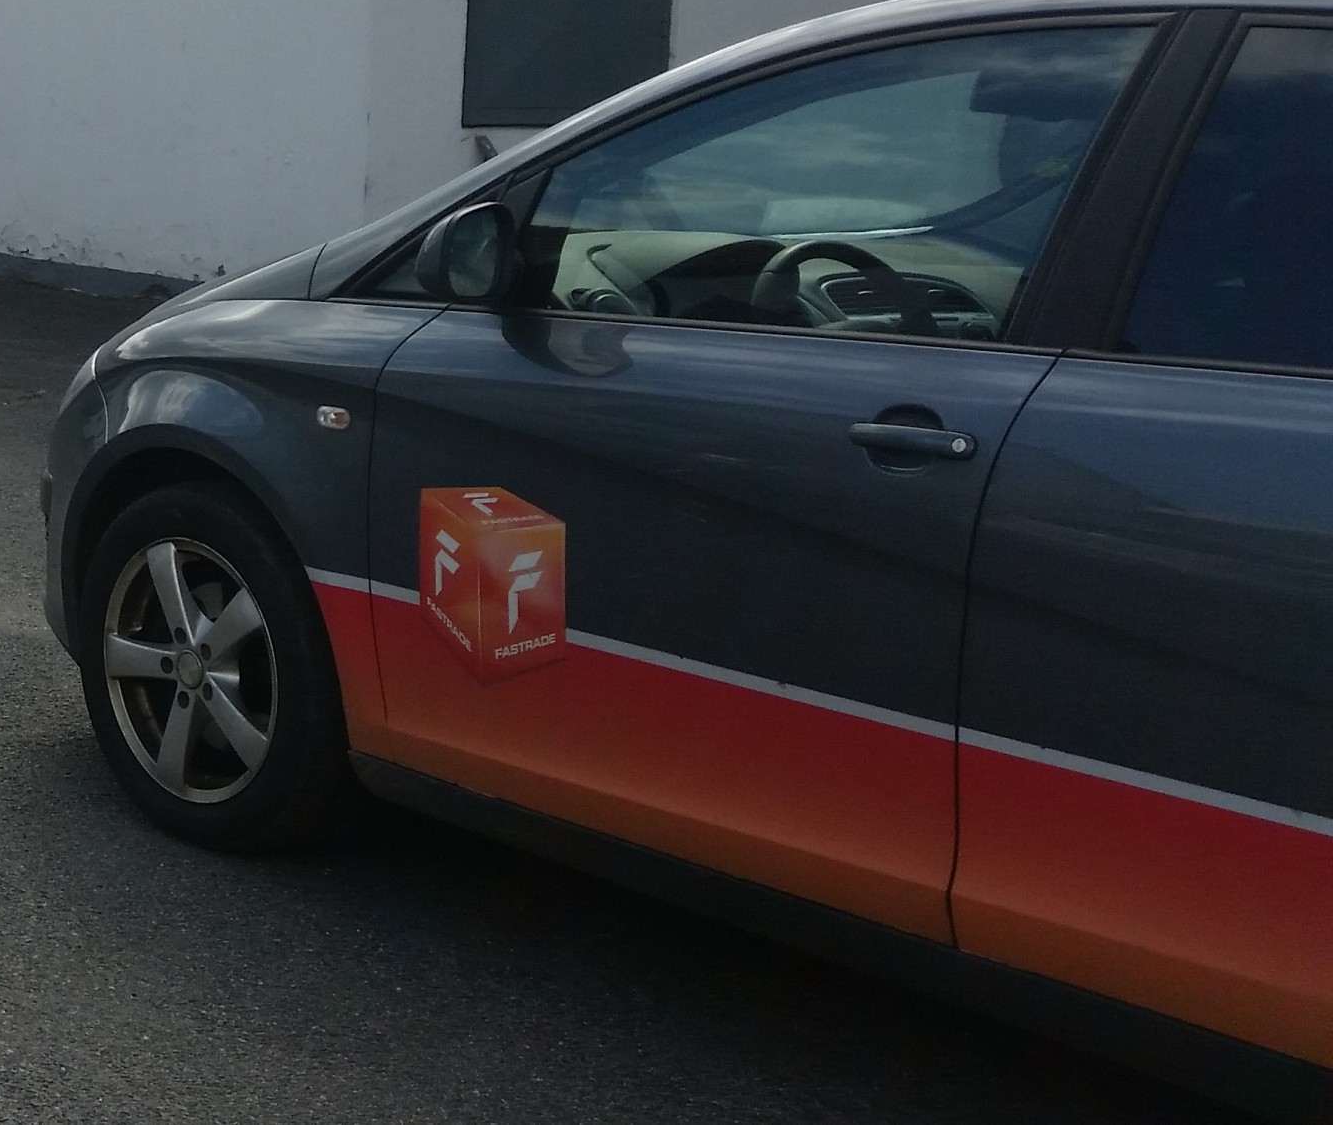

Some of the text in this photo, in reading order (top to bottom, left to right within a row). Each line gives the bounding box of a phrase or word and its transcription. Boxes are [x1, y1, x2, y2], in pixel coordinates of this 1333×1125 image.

[481, 514, 545, 525] FASTRADE
[507, 550, 543, 635] F
[426, 596, 472, 653] FASTRADE
[494, 633, 556, 659] FASTRADE
